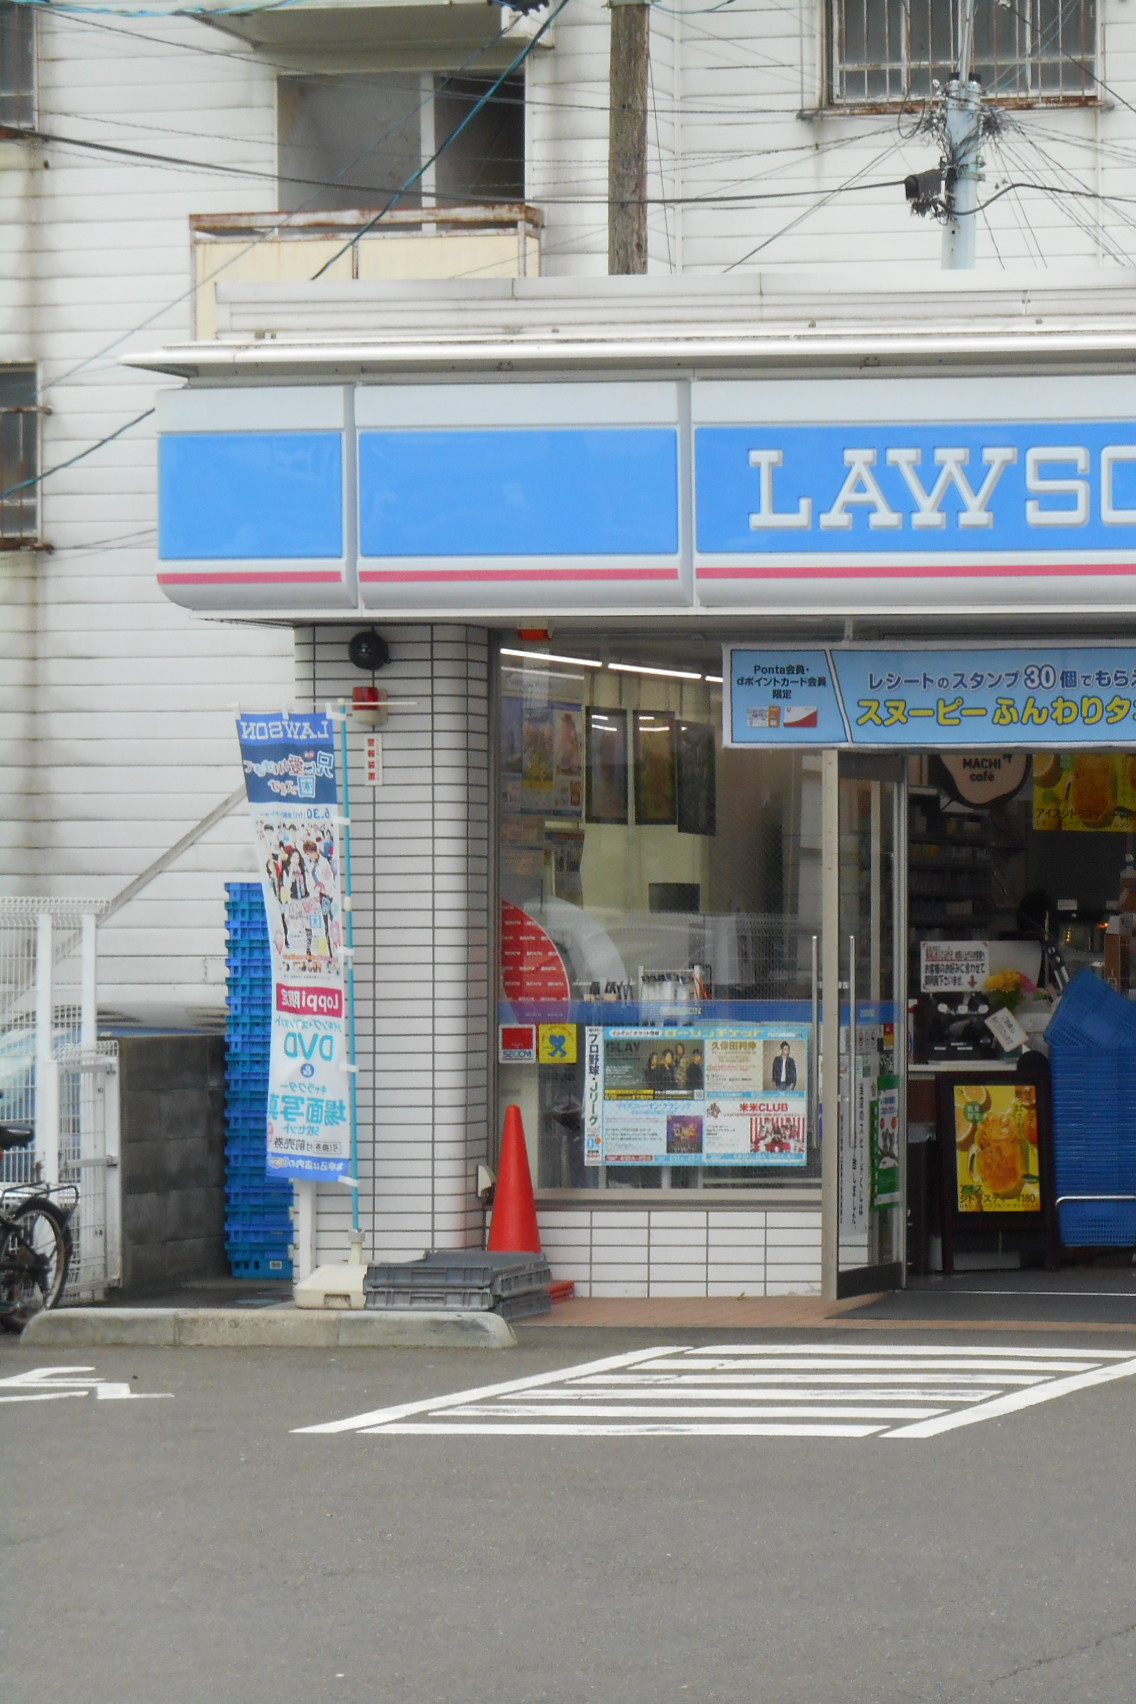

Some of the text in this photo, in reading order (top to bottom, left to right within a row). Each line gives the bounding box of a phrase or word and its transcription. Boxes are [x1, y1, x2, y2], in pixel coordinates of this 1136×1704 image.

[736, 677, 827, 687] dポイントカード会員
[772, 689, 792, 700] 限定
[963, 757, 1001, 769] MACHI
[605, 1041, 642, 1053] GLAY
[502, 1050, 532, 1059] SECOM
[739, 1102, 789, 1113] 米米CLUB
